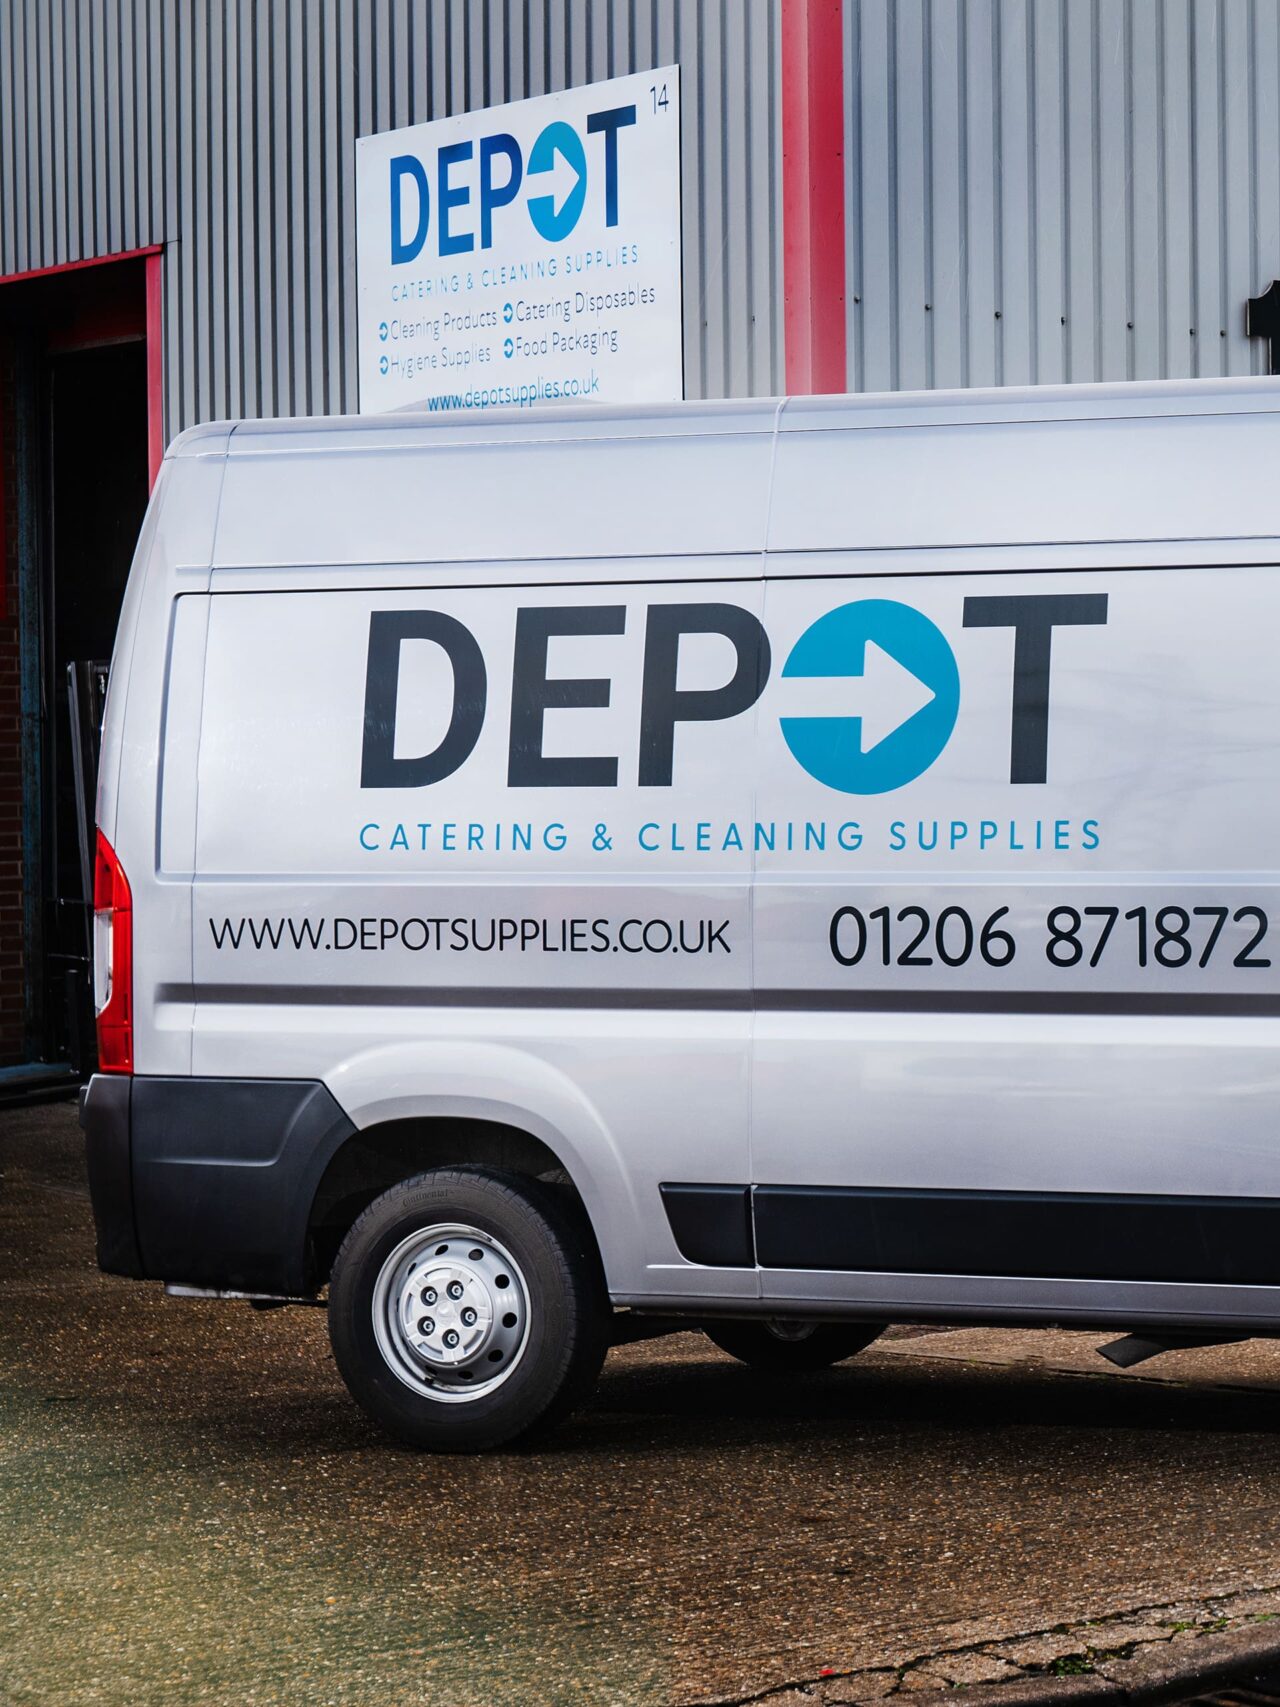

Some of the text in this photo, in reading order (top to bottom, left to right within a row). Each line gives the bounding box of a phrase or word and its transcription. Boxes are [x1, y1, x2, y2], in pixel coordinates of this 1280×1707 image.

[650, 83, 669, 114] 14
[390, 104, 636, 266] DEPOT
[392, 245, 638, 301] CATERING & CLEANING SUPPLIES
[516, 282, 656, 322] Catering Disposables
[391, 308, 497, 341] Cleaning Products
[516, 327, 618, 356] Food Packaging
[391, 344, 491, 379] Hygiene Supplies
[428, 369, 599, 411] www.depotsupplies.co.uk
[360, 593, 1109, 796] DEPOT
[359, 820, 1101, 851] CATERING & CLEANING SUPPLIES
[209, 918, 731, 954] WWW.DEPOTSUPPLIES.CO.UK
[830, 906, 1272, 969] 01206 871872
